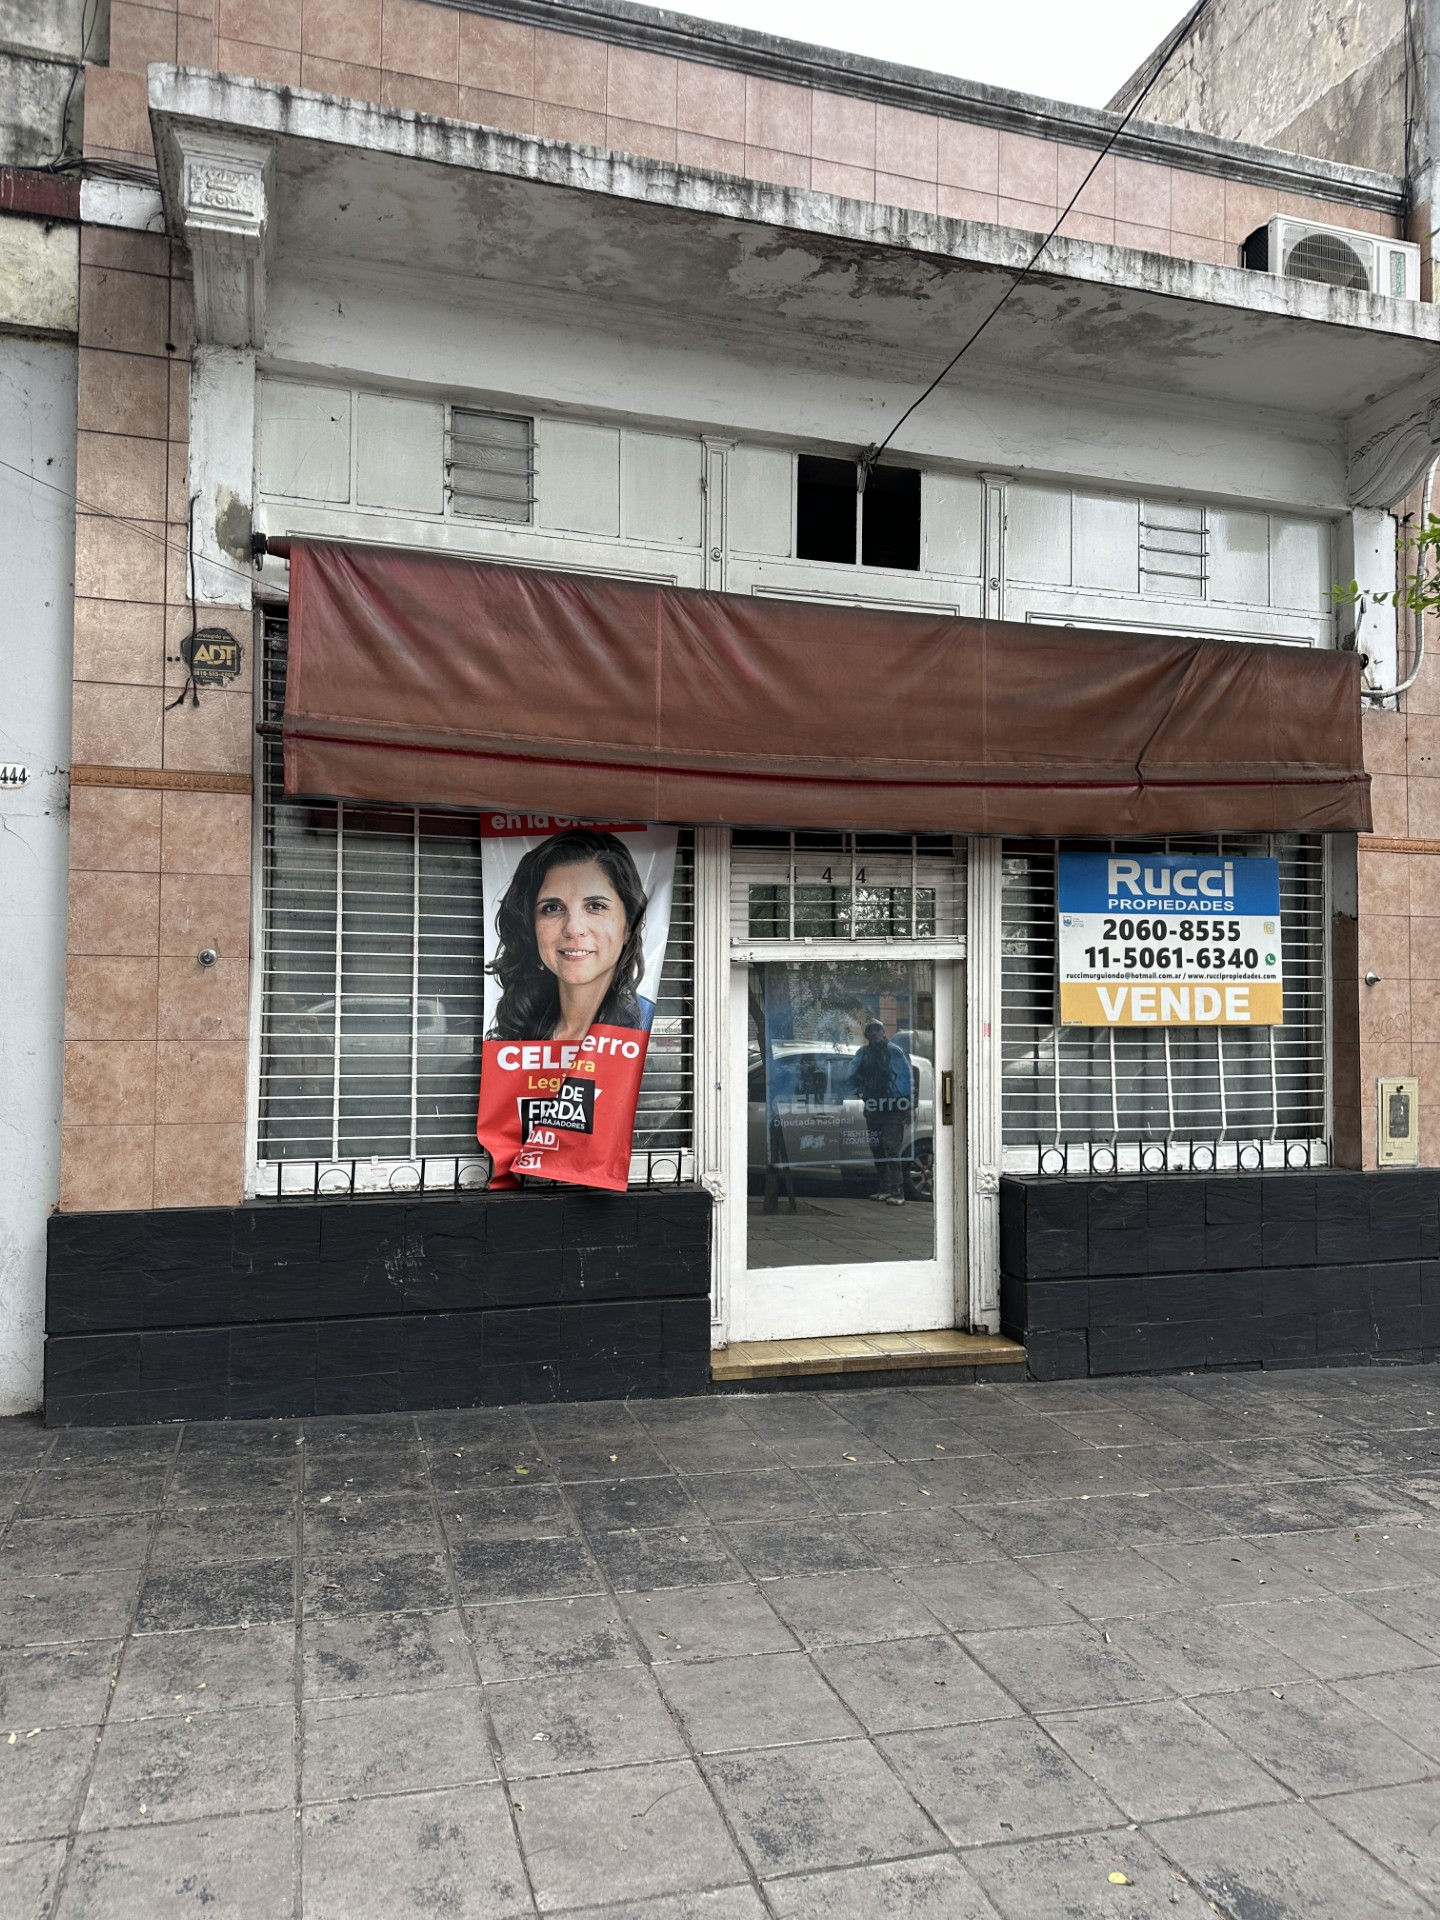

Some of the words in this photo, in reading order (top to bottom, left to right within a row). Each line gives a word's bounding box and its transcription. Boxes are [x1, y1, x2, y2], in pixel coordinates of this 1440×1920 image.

[193, 644, 236, 665] ADT
[1107, 858, 1235, 898] Rucci
[1108, 898, 1235, 912] PROPIEDADES
[1102, 918, 1242, 942] 2060-8555
[1084, 946, 1259, 969] 11-5061-6340
[1066, 971, 1182, 981] ruccimurguiondo@hotmail.com.ar
[1187, 973, 1277, 981] www.ruccipropiedades.com
[1096, 986, 1251, 1022] VENDE
[497, 1045, 581, 1071] CELE
